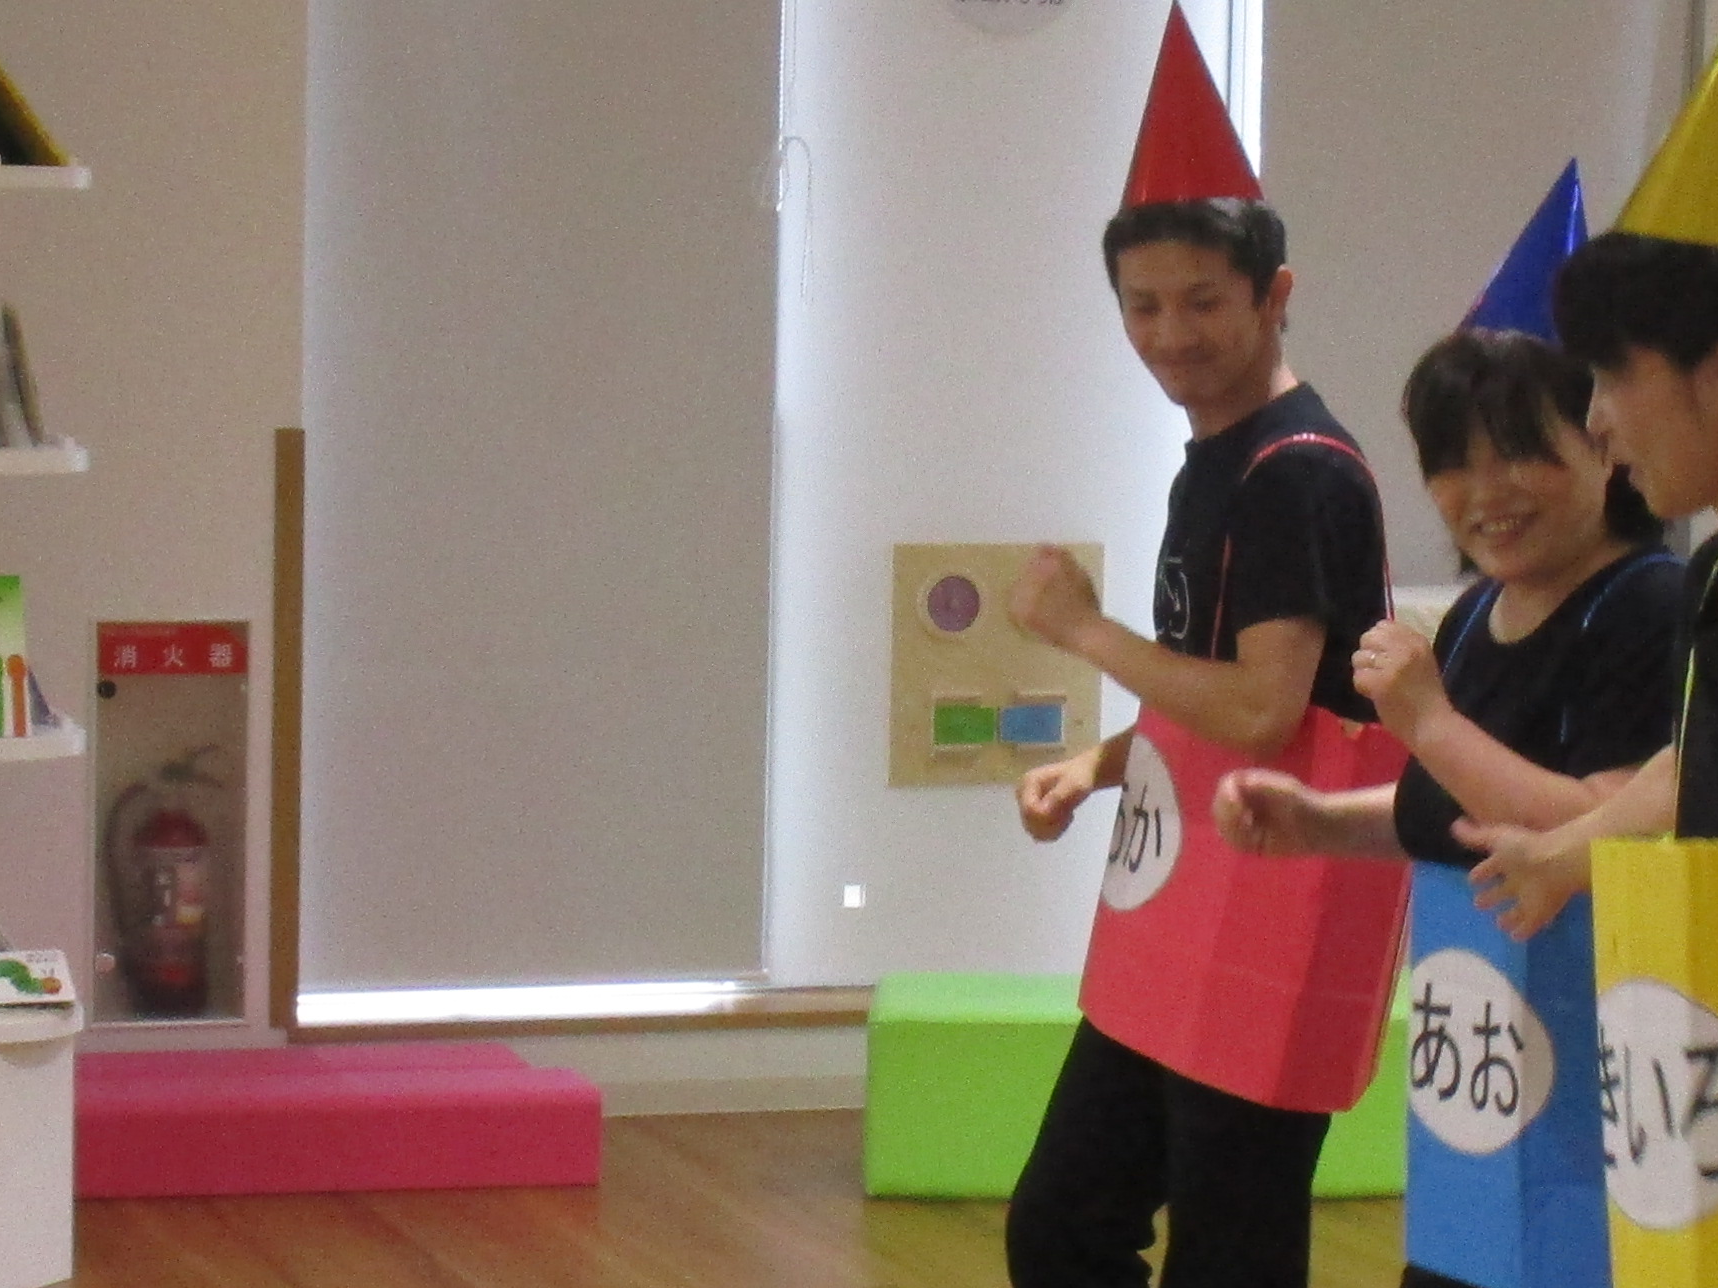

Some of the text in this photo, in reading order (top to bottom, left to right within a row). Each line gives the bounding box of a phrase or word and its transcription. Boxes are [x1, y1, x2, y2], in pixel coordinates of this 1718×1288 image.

[113, 642, 234, 669] 消火器
[1410, 982, 1525, 1117] あお
